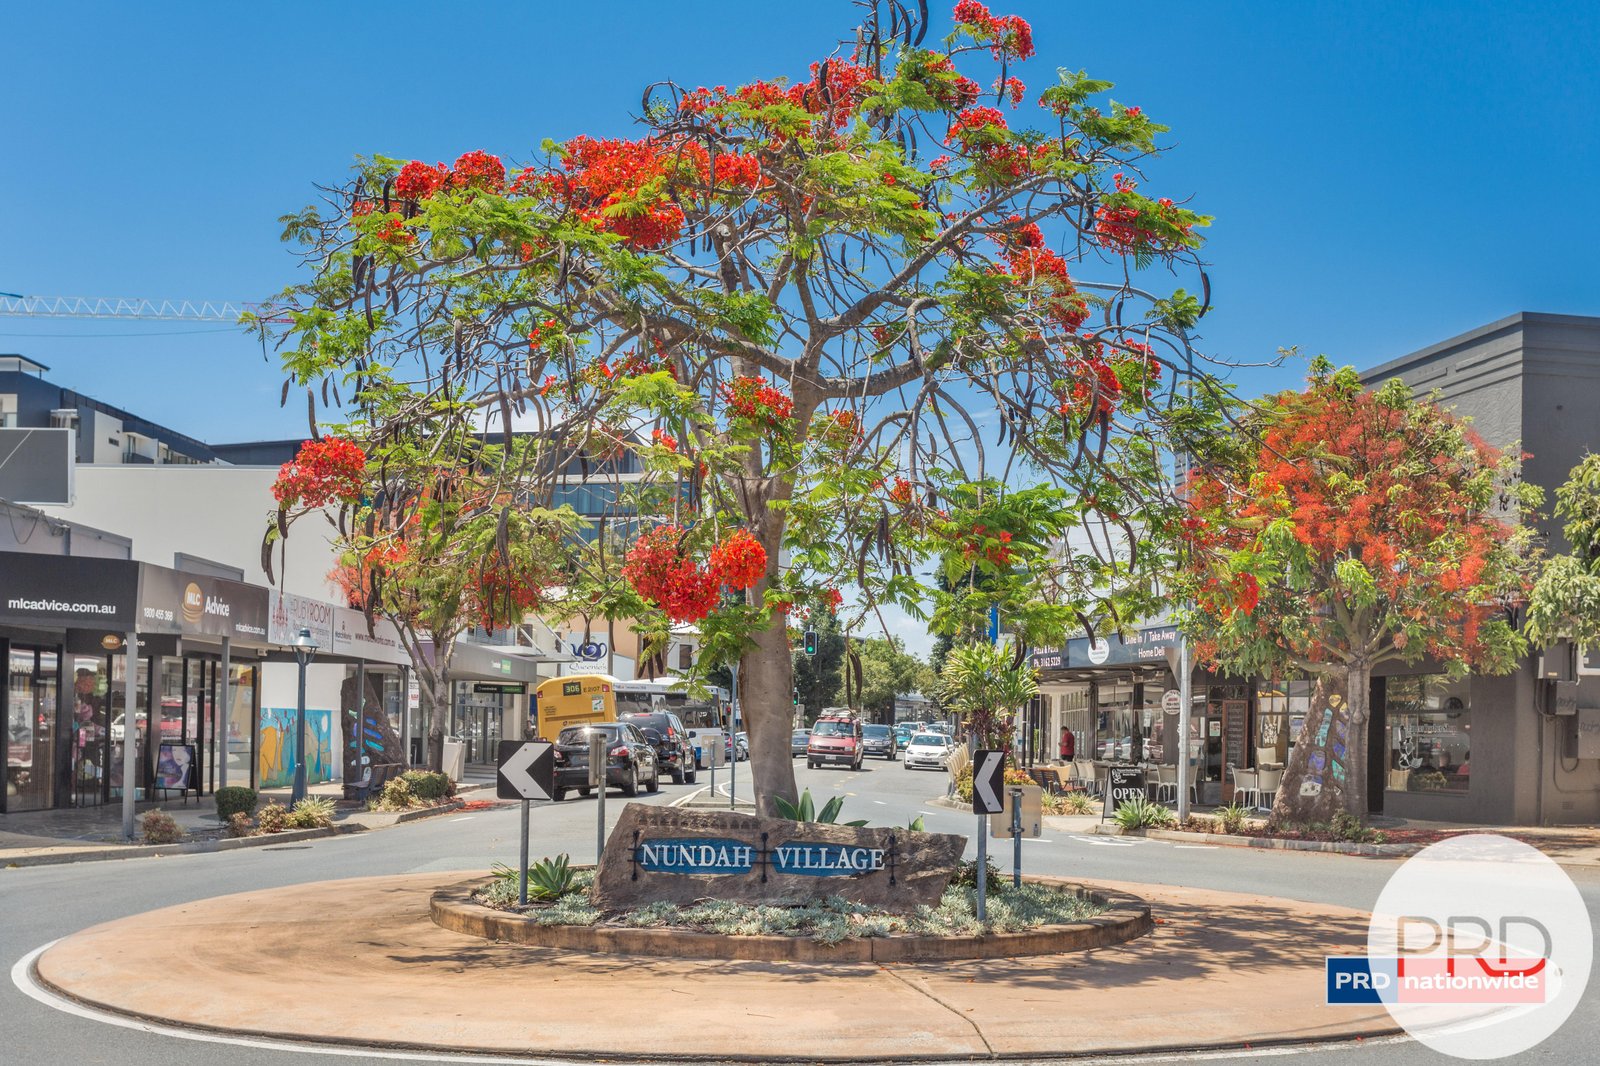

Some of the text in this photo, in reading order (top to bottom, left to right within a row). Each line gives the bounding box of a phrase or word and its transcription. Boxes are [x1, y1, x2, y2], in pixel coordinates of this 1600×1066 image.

[187, 592, 201, 606] MLC
[8, 598, 116, 614] mlcadvice.com.au
[205, 596, 230, 617] Advice
[144, 607, 156, 619] 1800
[155, 609, 165, 620] 455
[235, 622, 266, 635] mlcadvice.com.au
[122, 638, 146, 647] Aice
[1149, 631, 1161, 642] Take
[1161, 630, 1176, 642] Away
[1138, 646, 1166, 658] Home Deli
[565, 685, 580, 693] 306
[1113, 788, 1145, 800] OPEN
[640, 844, 886, 871] NUNDAH VILLAGE
